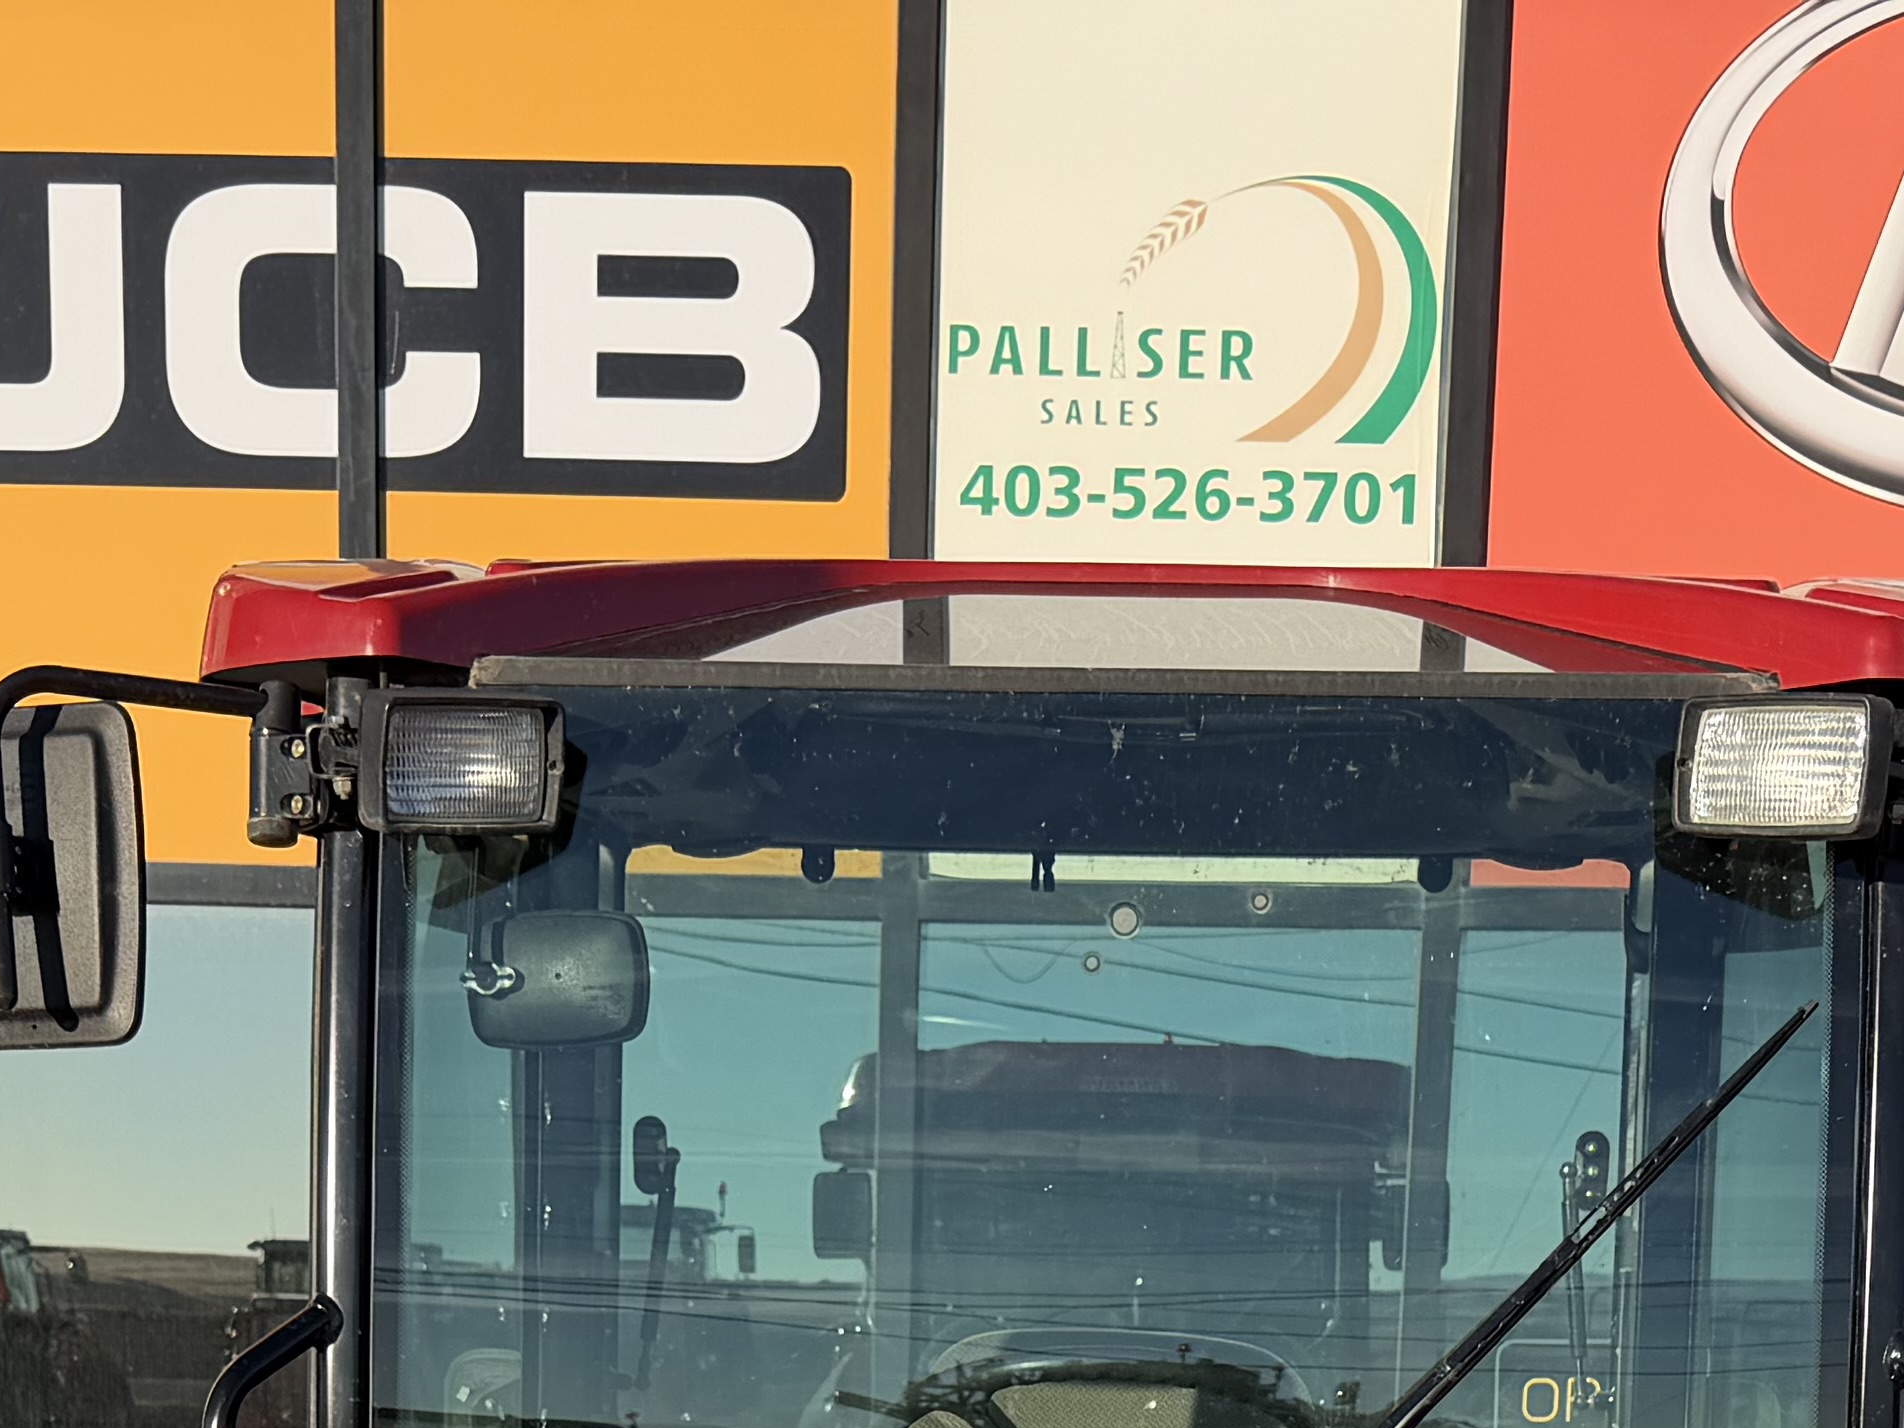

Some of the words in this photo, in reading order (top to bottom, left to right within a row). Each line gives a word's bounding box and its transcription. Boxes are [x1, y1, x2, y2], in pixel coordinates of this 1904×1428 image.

[947, 311, 1255, 382] PALLISER
[1039, 398, 1159, 428] SALES
[958, 464, 1418, 526] 403-526-3701
